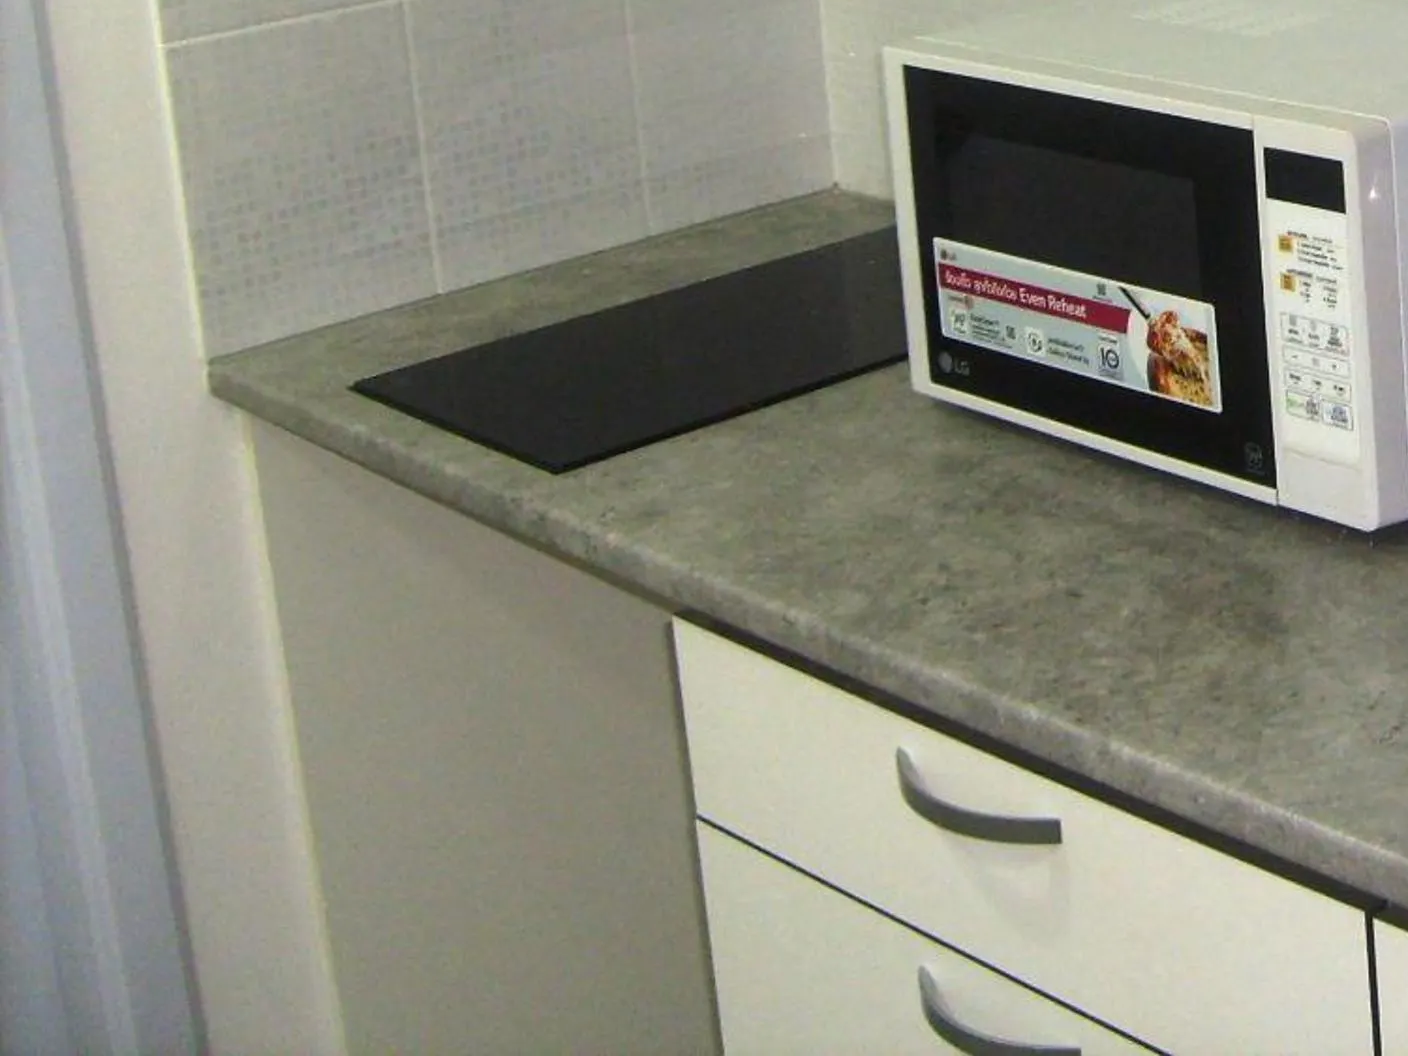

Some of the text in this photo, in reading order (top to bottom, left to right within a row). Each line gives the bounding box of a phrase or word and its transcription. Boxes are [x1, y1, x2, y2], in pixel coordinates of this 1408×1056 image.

[1018, 287, 1047, 308] Even
[1046, 294, 1087, 319] Reheat
[953, 358, 970, 376] LG
